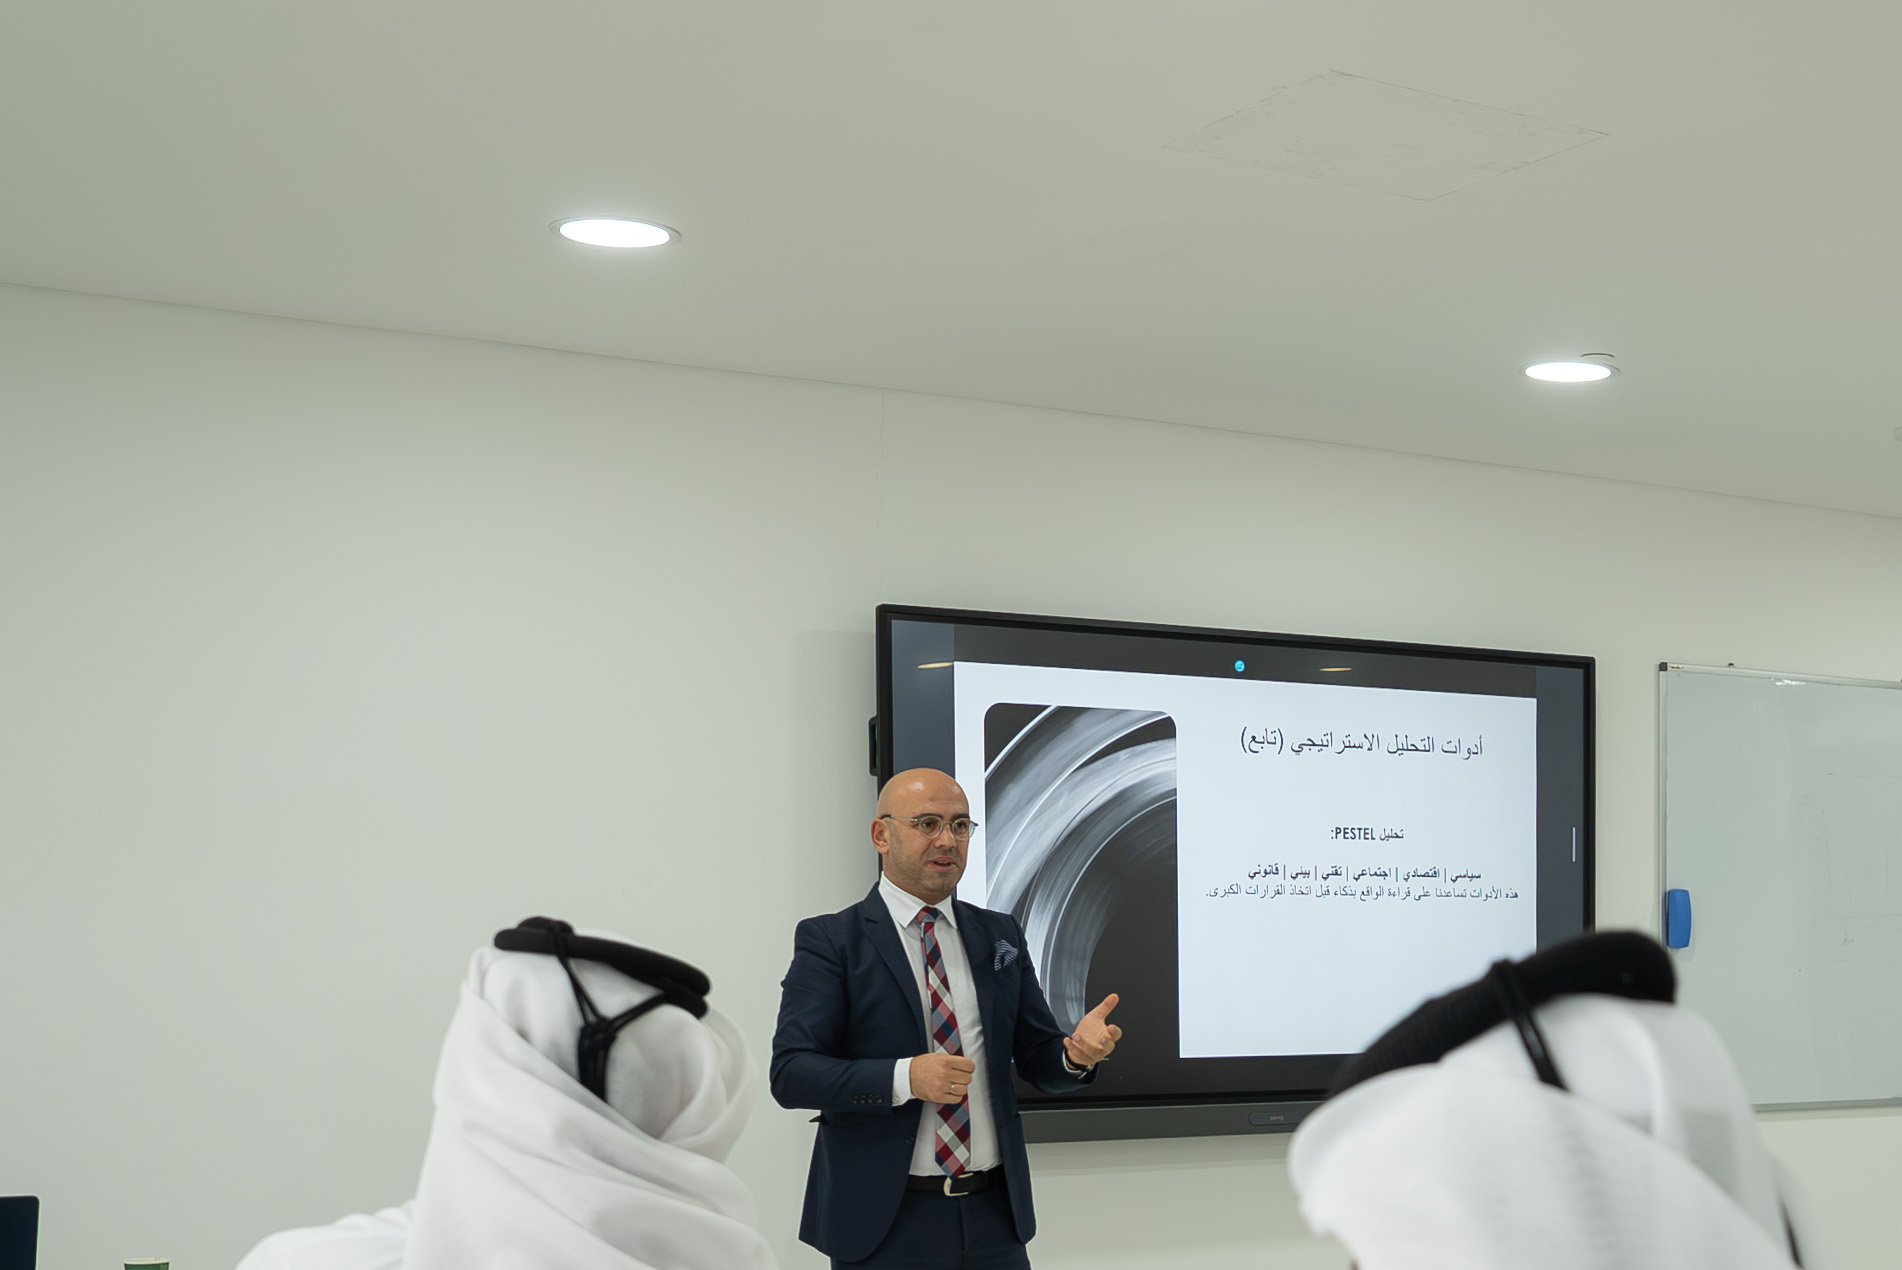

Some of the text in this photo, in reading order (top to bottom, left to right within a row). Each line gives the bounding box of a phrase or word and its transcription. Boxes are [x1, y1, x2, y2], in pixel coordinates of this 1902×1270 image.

[1241, 726, 1483, 760] أدوات التحليل الاستراتيجي (تابع)
[1379, 827, 1404, 842] تحليل
[1248, 863, 1279, 879] قانوني
[1321, 865, 1342, 880] تقني
[1353, 867, 1391, 881] اجتماعي
[1403, 866, 1440, 882] اقتصادي
[1450, 868, 1481, 883] سياسي
[1245, 884, 1286, 899] القرارات
[1290, 884, 1312, 896] اتخاذ
[1315, 884, 1330, 898] قبل
[1334, 885, 1356, 899] بذكاء
[1359, 886, 1384, 901] الواقع
[1388, 886, 1411, 900] قراءة
[1413, 886, 1431, 900] على
[1435, 887, 1467, 899] تساعدنا
[1470, 885, 1502, 901] الأدوات
[1505, 888, 1519, 898] هذه
